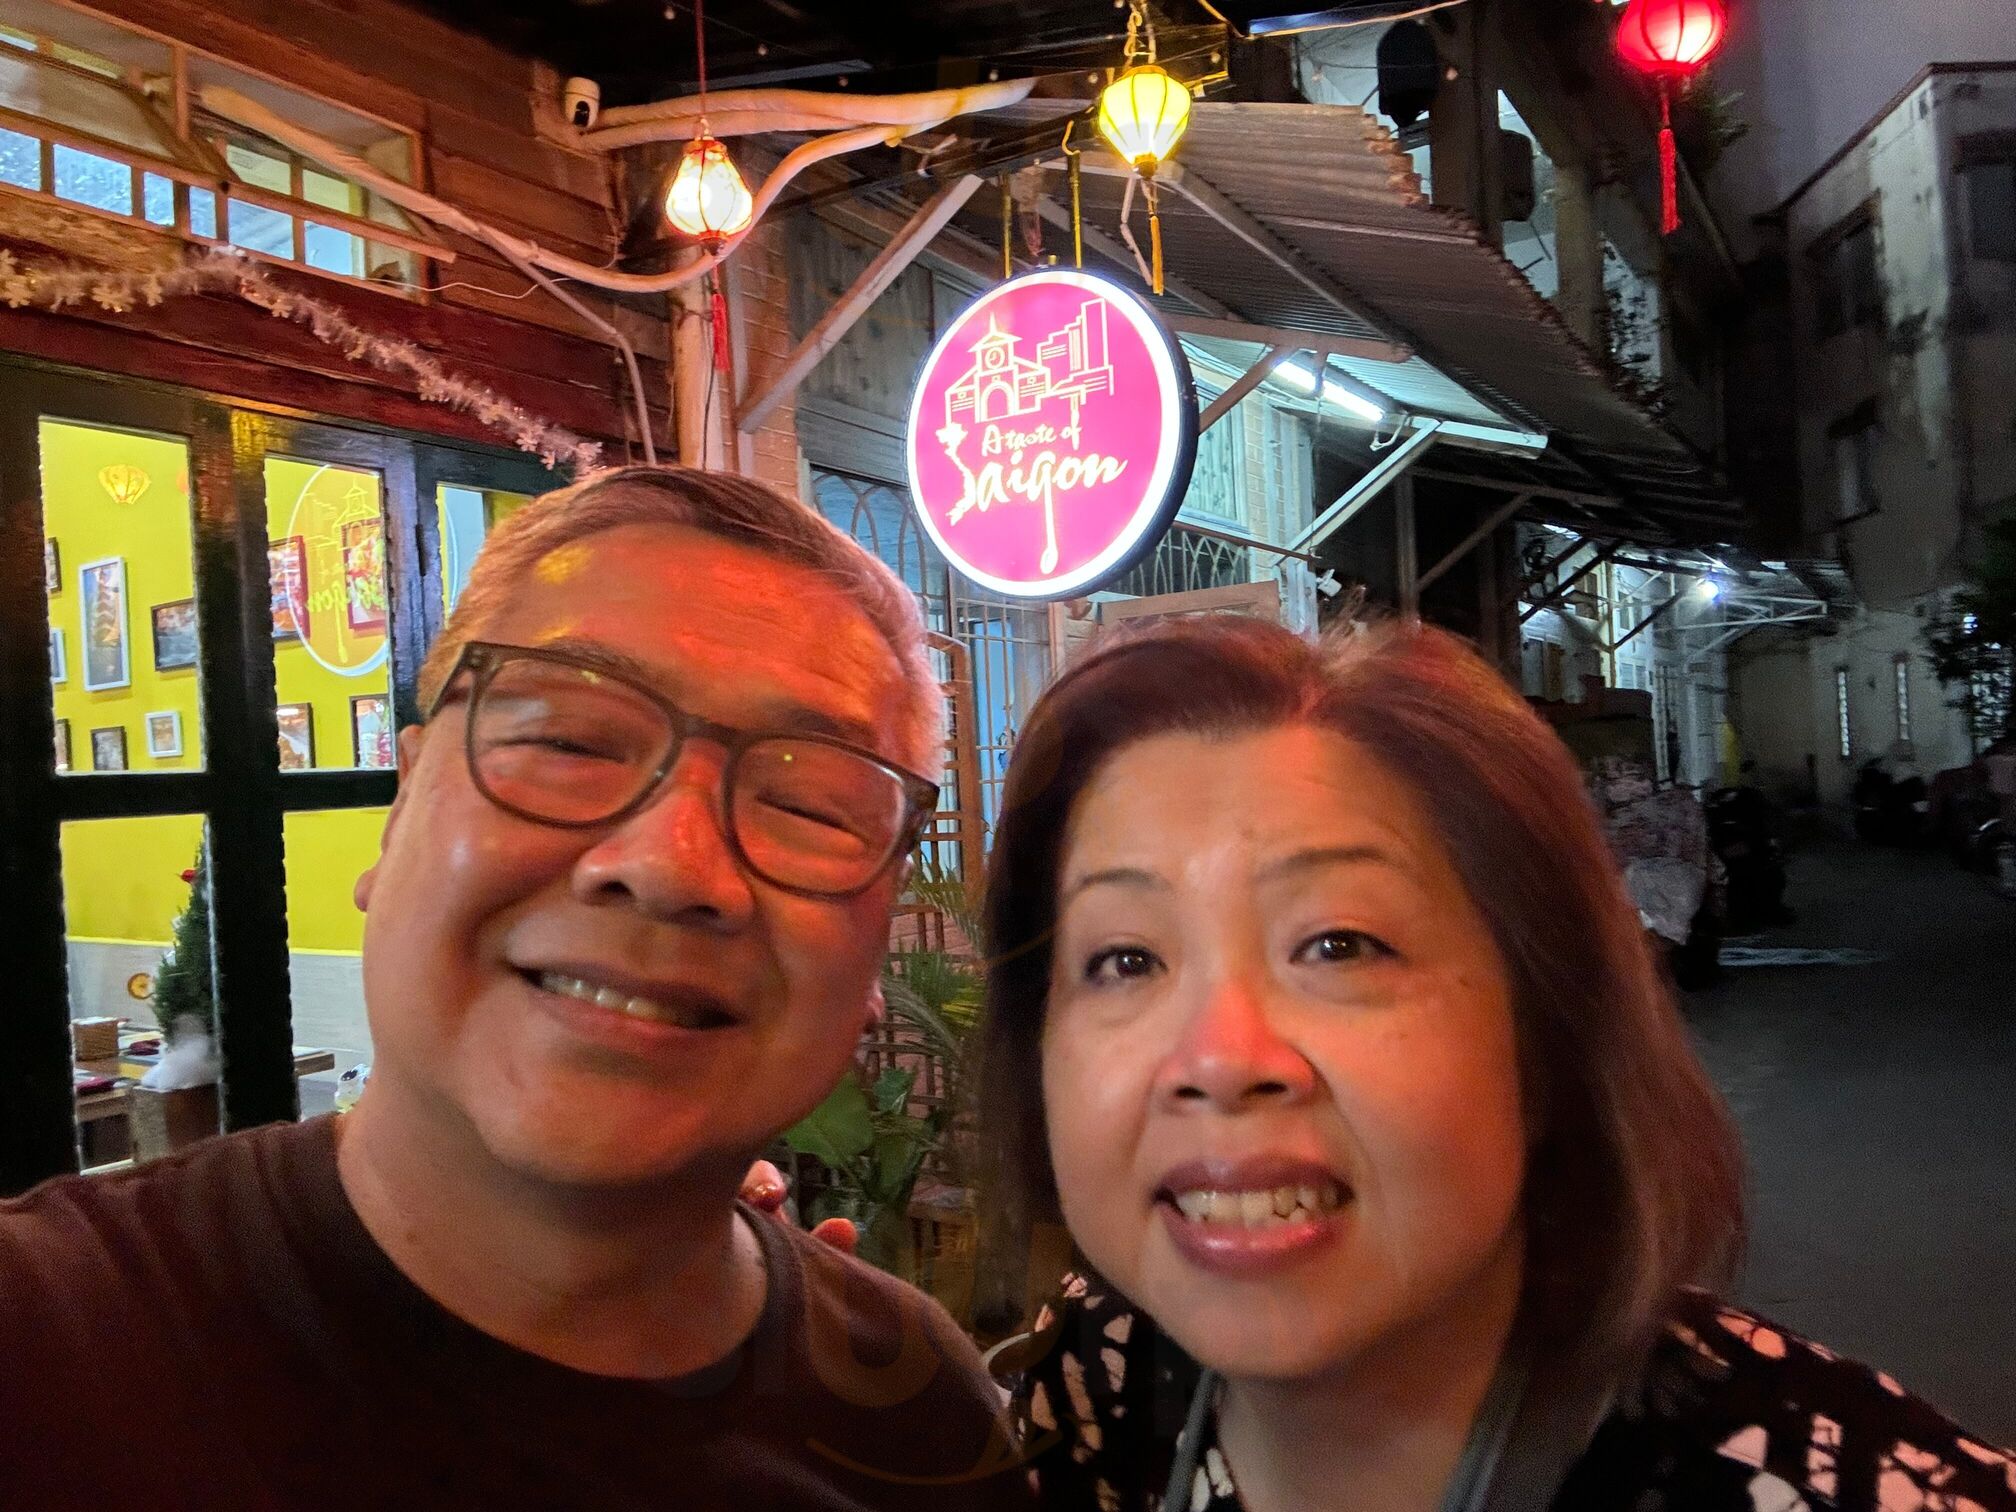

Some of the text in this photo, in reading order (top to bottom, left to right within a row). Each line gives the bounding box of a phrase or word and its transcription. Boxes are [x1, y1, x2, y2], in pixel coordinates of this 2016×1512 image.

[982, 408, 1082, 457] A taste of
[934, 422, 1129, 575] Saigon
